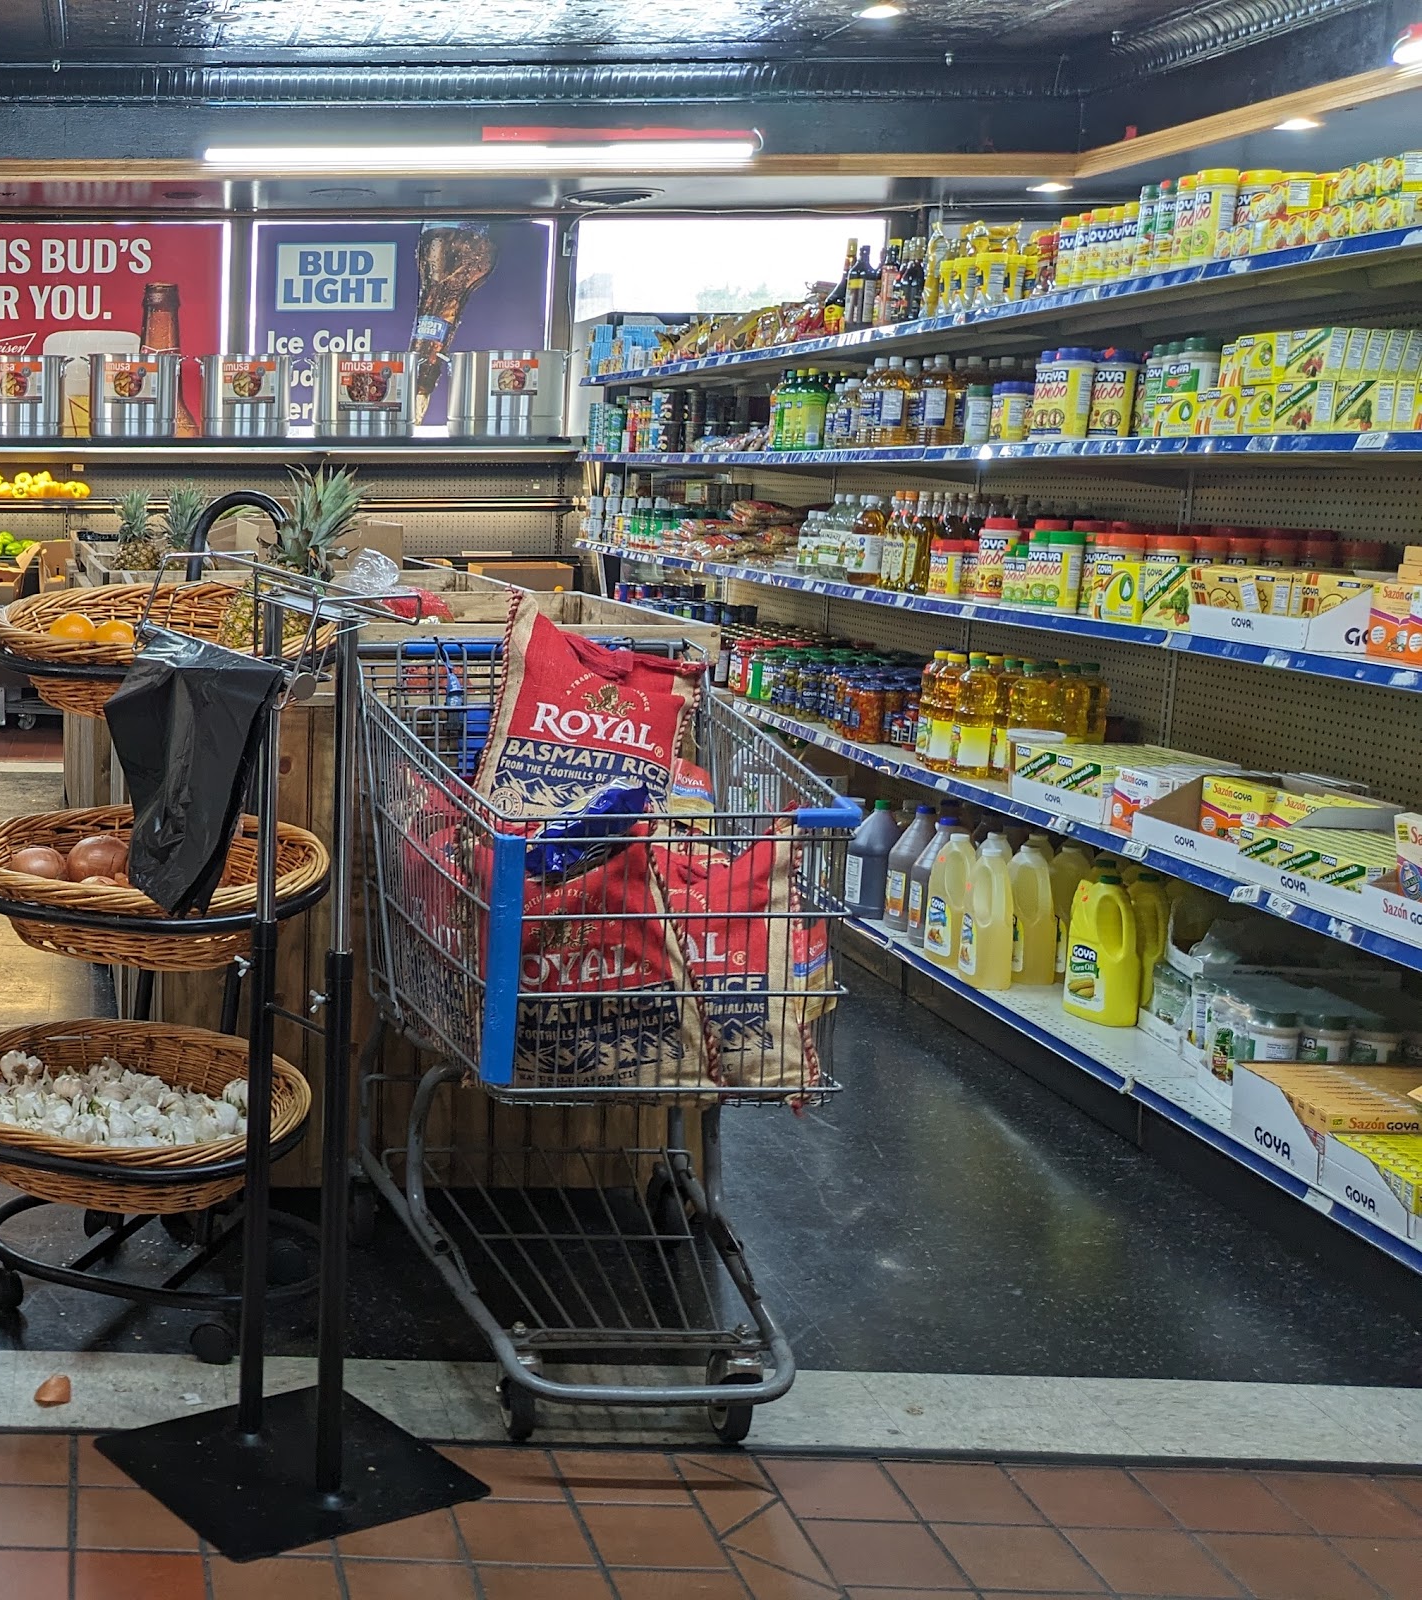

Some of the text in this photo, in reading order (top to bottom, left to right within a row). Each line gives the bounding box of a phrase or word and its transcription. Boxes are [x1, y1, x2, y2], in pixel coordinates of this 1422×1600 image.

[41, 238, 153, 274] BUD'S
[298, 250, 374, 276] BUD
[283, 277, 388, 304] LIGHT
[28, 285, 112, 320] YOU.
[267, 329, 372, 354] Ice Cold
[1094, 371, 1126, 383] GOYA
[1097, 565, 1113, 575] GOYA
[1191, 581, 1207, 590] GOYA
[1301, 586, 1320, 596] GOYA
[1231, 617, 1252, 629] GOYA
[529, 702, 656, 752] ROYAL
[506, 739, 670, 784] BASMATI RICE
[1058, 756, 1073, 768] GOYA
[500, 756, 607, 782] FROM THE FOOTHILLS OF
[678, 773, 705, 786] ROYAL
[1134, 777, 1149, 788] GOYA
[1045, 793, 1062, 805] GOYA
[1213, 783, 1252, 802] Sazón GOYA
[1284, 797, 1306, 813] Sazón
[1246, 812, 1255, 822] 20
[1174, 835, 1195, 849] GOYA
[1279, 842, 1294, 852] GOYA
[1321, 855, 1337, 866] GOYA
[1280, 876, 1307, 892] GOYA
[932, 897, 946, 911] GOYA
[1383, 898, 1408, 920] Sazón
[1073, 946, 1097, 961] GOYA
[520, 944, 638, 986] OYAL
[1071, 963, 1095, 972] Corn Oil
[1348, 1117, 1420, 1131] Sazón GOYA
[1254, 1126, 1291, 1161] GOYA
[1345, 1185, 1376, 1213] GOYA
